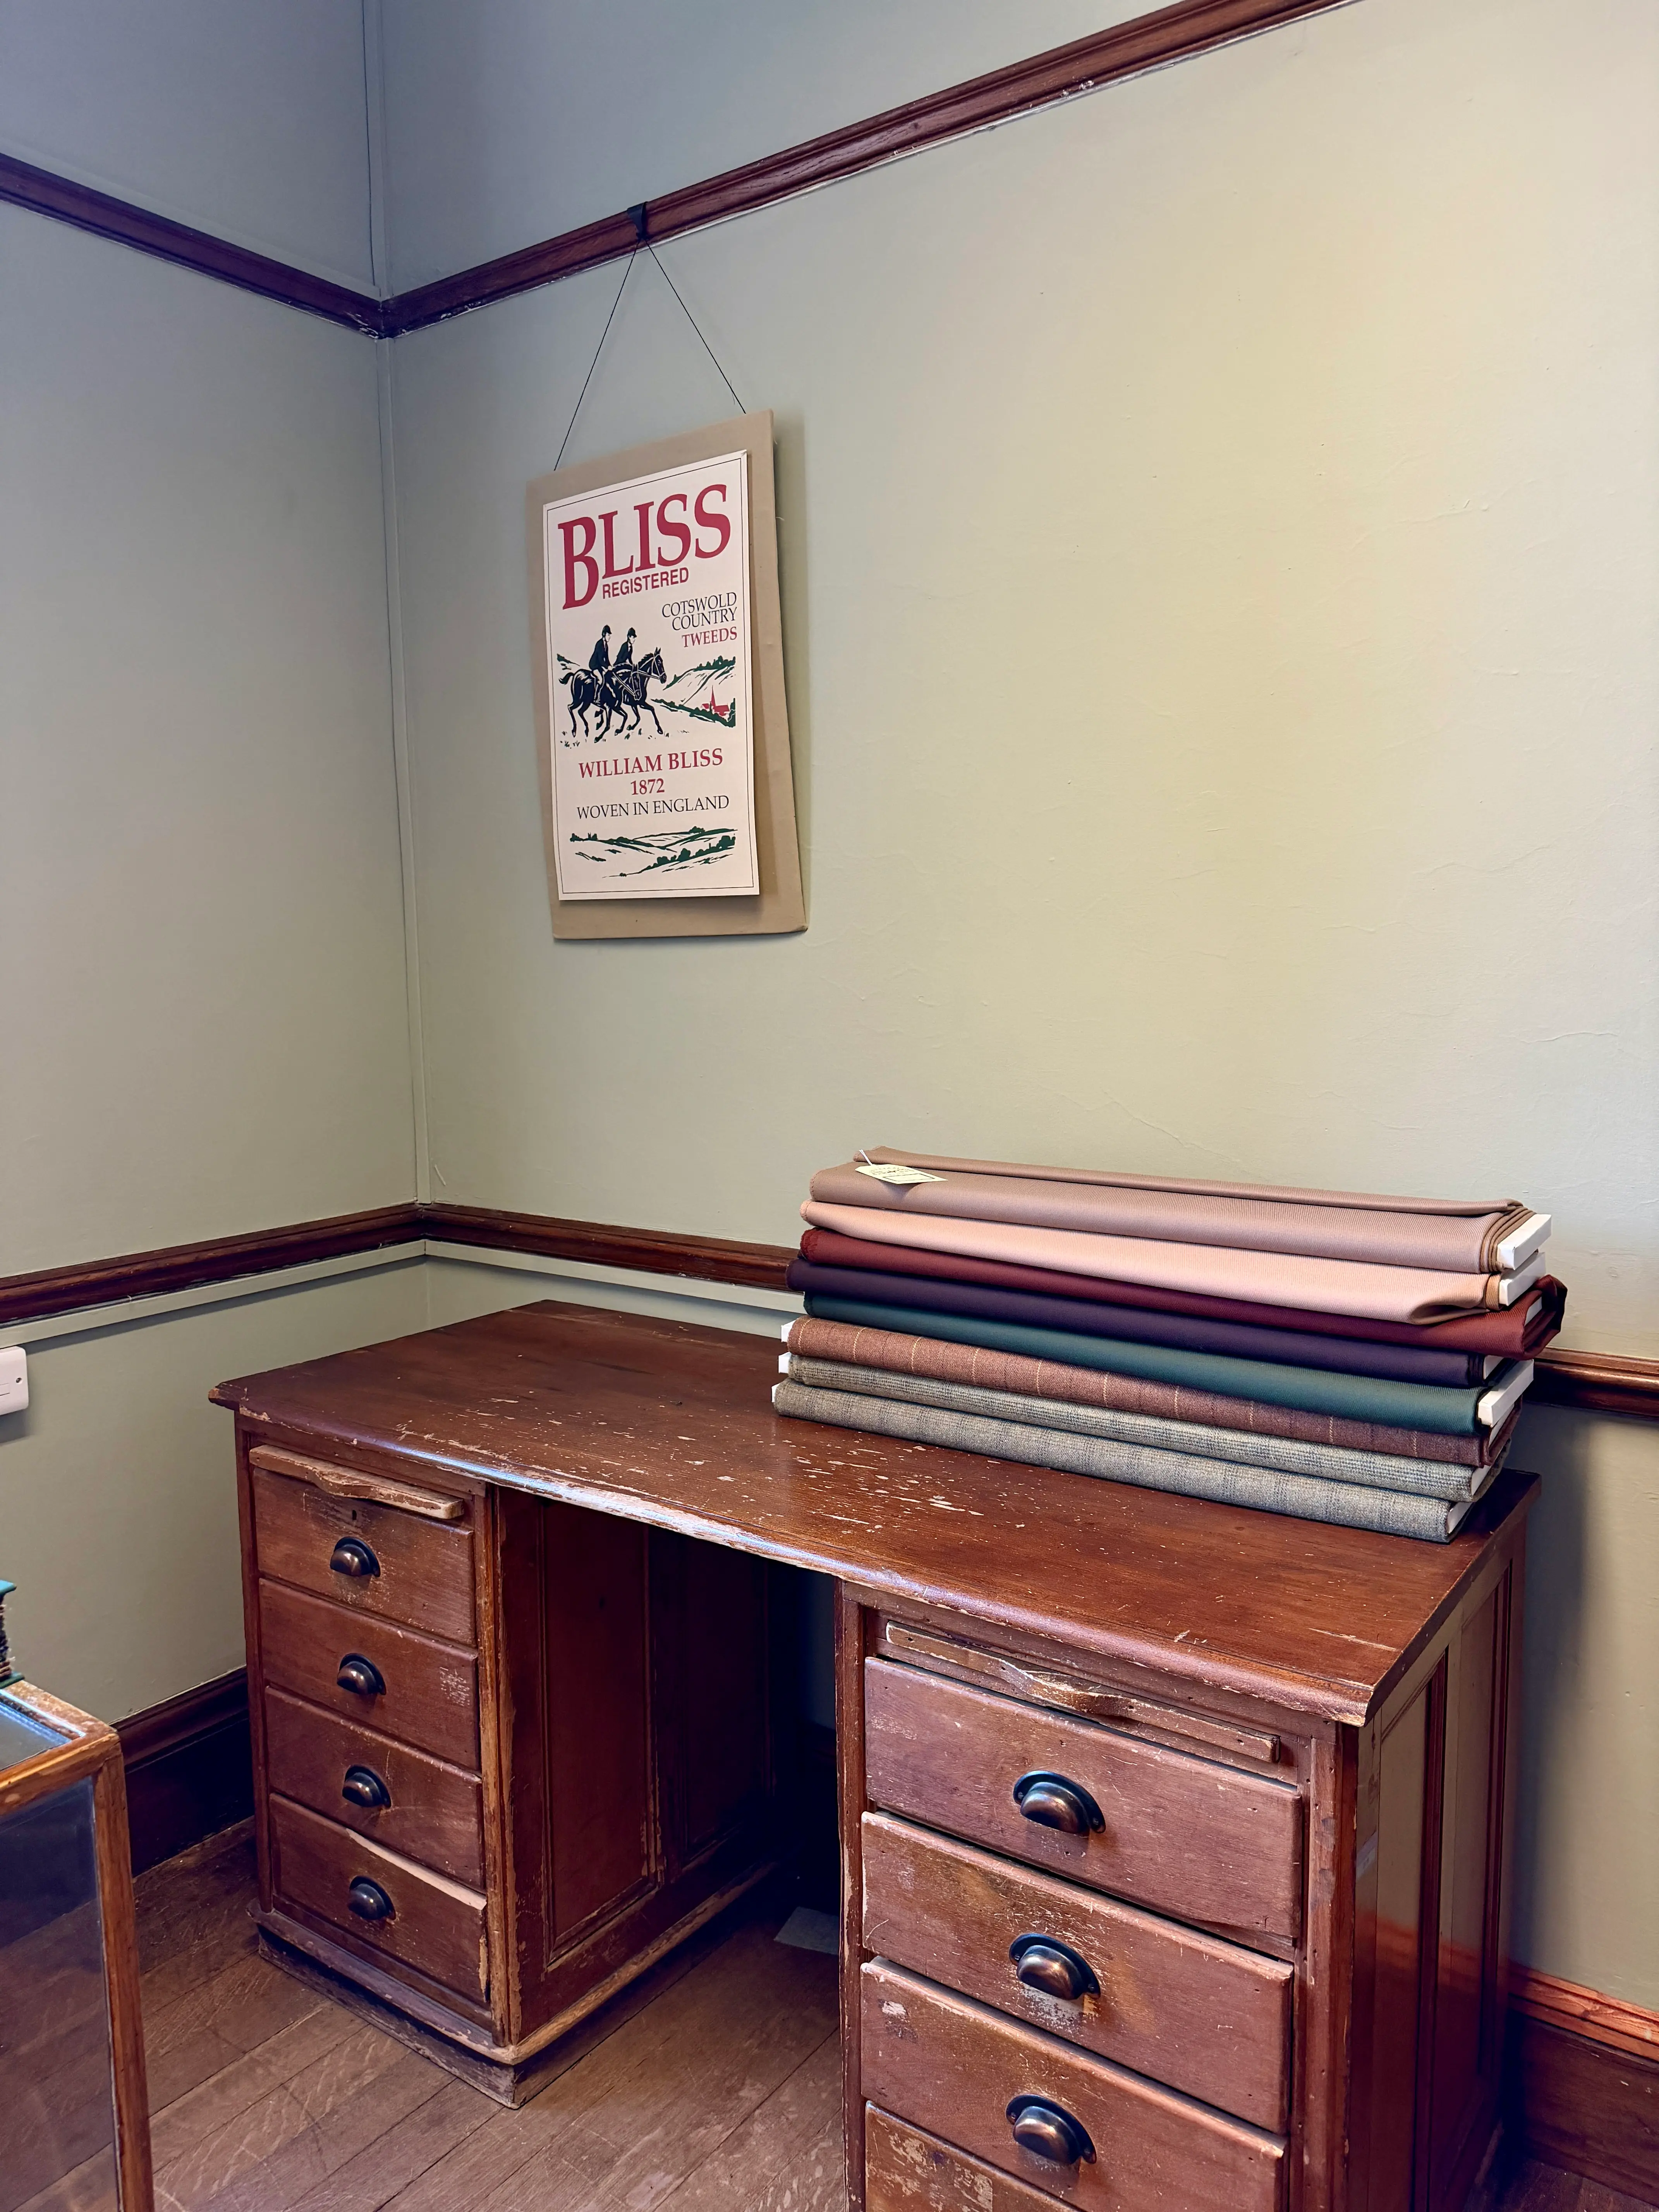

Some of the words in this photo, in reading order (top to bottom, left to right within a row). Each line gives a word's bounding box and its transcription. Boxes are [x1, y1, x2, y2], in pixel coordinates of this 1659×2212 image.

[558, 484, 731, 610] BLISS
[602, 567, 689, 599] REGISTERED
[661, 592, 737, 618] COTSWOLD
[672, 607, 737, 630] COUNTRY
[681, 627, 737, 647] TWEEDS
[579, 754, 663, 778] WILLIAM
[668, 748, 723, 770] BLISS
[630, 778, 665, 795] 1872
[577, 802, 629, 819] WOVEN
[633, 801, 649, 816] IN
[653, 795, 729, 814] ENGLAND
